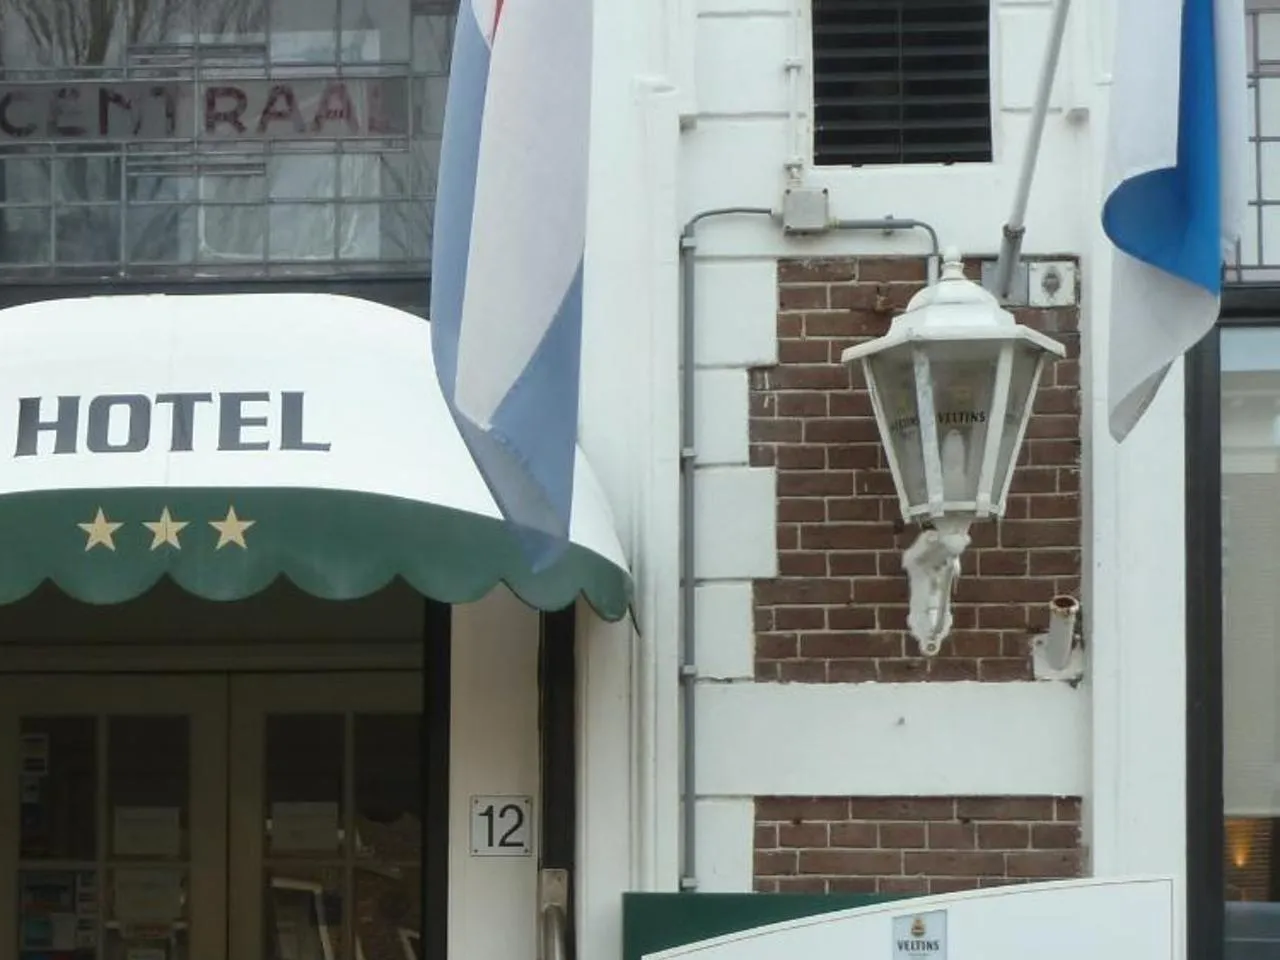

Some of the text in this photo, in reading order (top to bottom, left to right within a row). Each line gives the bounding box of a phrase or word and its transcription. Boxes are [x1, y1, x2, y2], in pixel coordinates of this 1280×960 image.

[14, 391, 332, 457] HOTEL
[478, 804, 524, 847] 12
[897, 940, 940, 951] VELTINS
